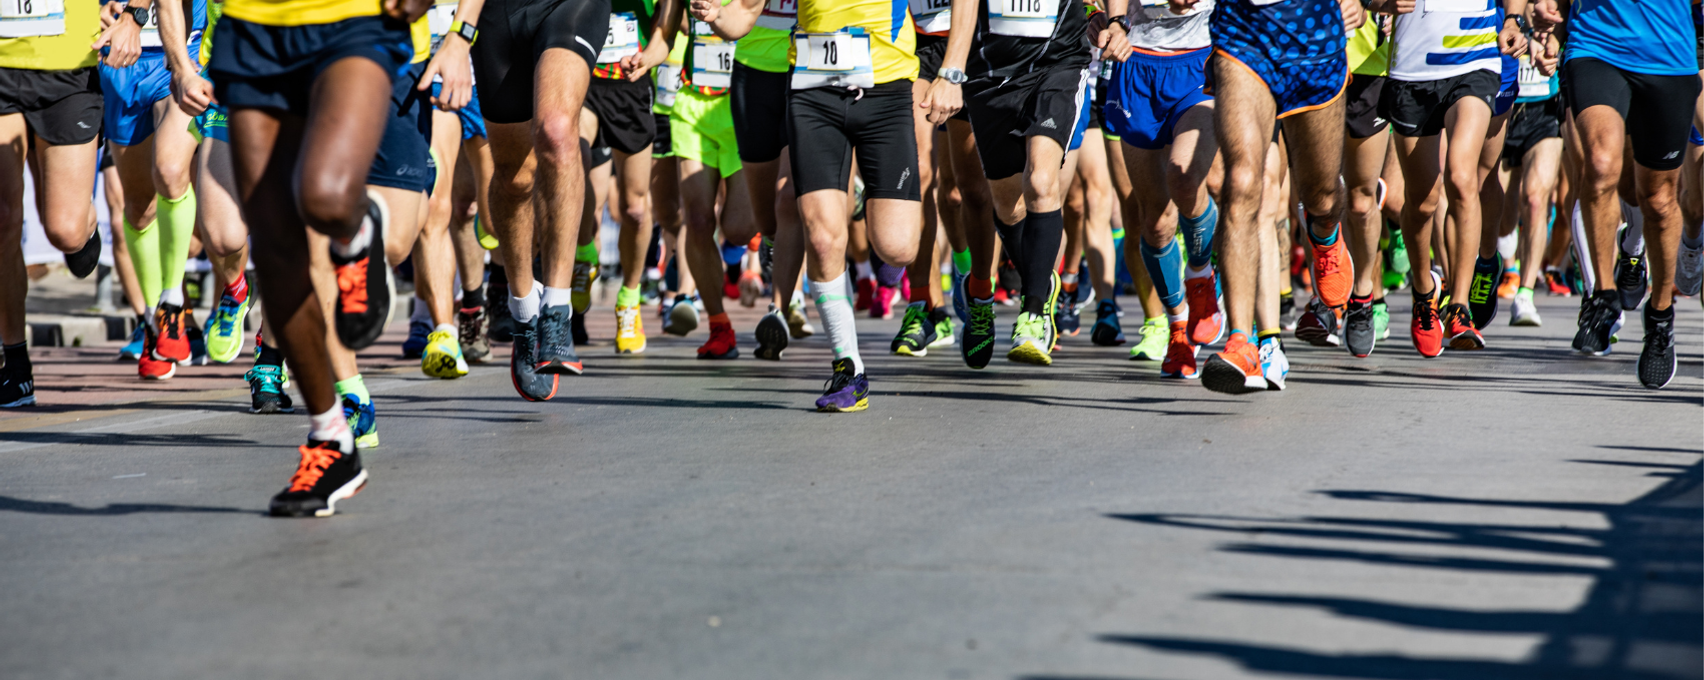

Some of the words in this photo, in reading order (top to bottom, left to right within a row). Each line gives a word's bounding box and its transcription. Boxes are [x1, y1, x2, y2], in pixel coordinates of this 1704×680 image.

[17, 0, 32, 14] 18
[717, 52, 731, 71] 16
[823, 41, 838, 65] 10
[967, 335, 994, 358] BROOKS
